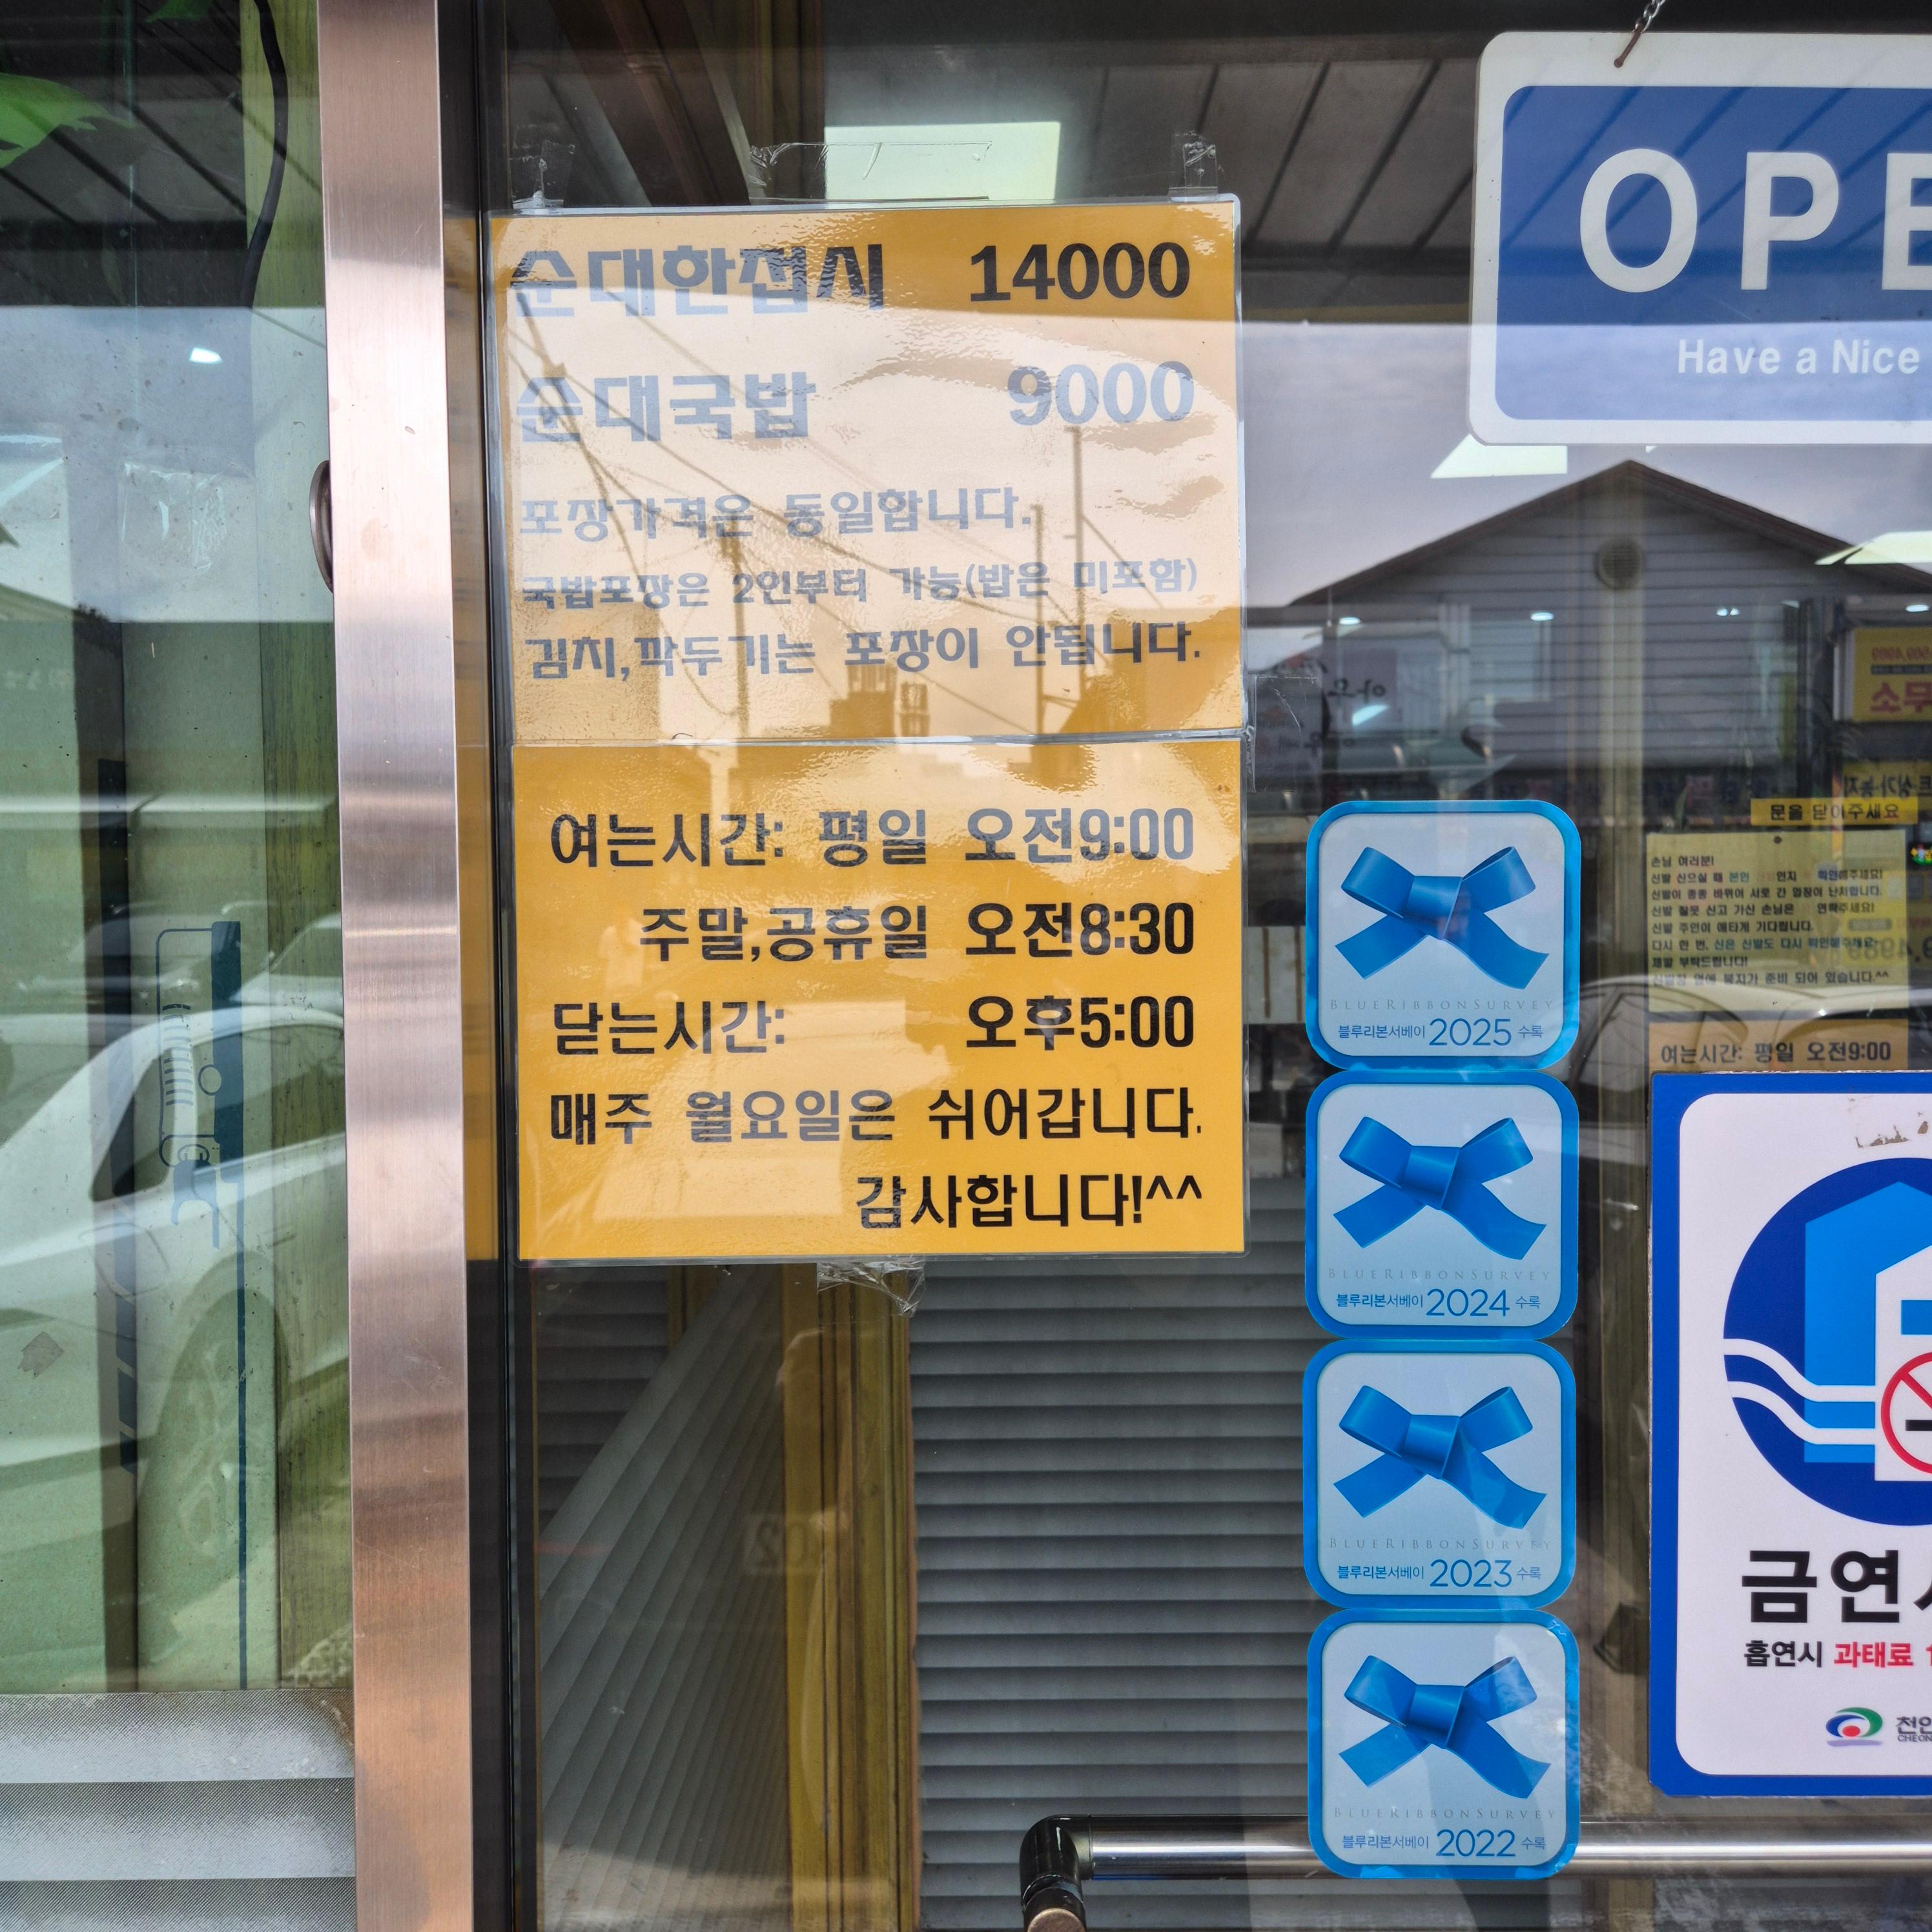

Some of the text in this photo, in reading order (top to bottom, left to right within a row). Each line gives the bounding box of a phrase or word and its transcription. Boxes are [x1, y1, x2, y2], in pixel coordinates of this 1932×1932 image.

[509, 242, 1190, 318] 순대한접시 14000
[1678, 338, 1920, 375] Have a Nice
[517, 361, 1195, 443] 순대국밥 9000
[520, 486, 1032, 542] 포장가격은 동일합니다.
[522, 558, 1198, 609] 국밥포장은 2인부터 가능(밥은 미포함)
[525, 621, 1200, 682] 김치,깍두기는 포장이 안됩니다.
[1770, 803, 1899, 821] 문을 닫아주세요
[551, 807, 1193, 868] 여는시간: 평일 오전9:00
[1651, 856, 1671, 867] 손님
[1651, 873, 1671, 884] 신발
[1652, 905, 1672, 917] 신발
[1652, 922, 1672, 934] 신발
[639, 902, 1193, 962] 주말,공휴일 오전8:30
[553, 994, 1193, 1055] 닫는시간: 오후5:00
[1339, 1018, 1543, 1046] 블루리본서베이 2025 수록
[1661, 1041, 1891, 1064] 여는시간: 평일 오전9:00
[550, 1087, 1202, 1145] 매주 월요일은 쉬어갑니다.
[856, 1173, 1202, 1229] 감사합니다!^^
[1337, 1289, 1541, 1317] 블루리본서베이 2024 수록
[1337, 1559, 1541, 1588] 블루리본서베이 2023 수록
[1742, 1550, 1932, 1623] 금연
[1744, 1640, 1822, 1668] 흡연시
[1834, 1641, 1914, 1668] 과태료
[1342, 1829, 1545, 1857] 블루리본서베이 2022 수록
